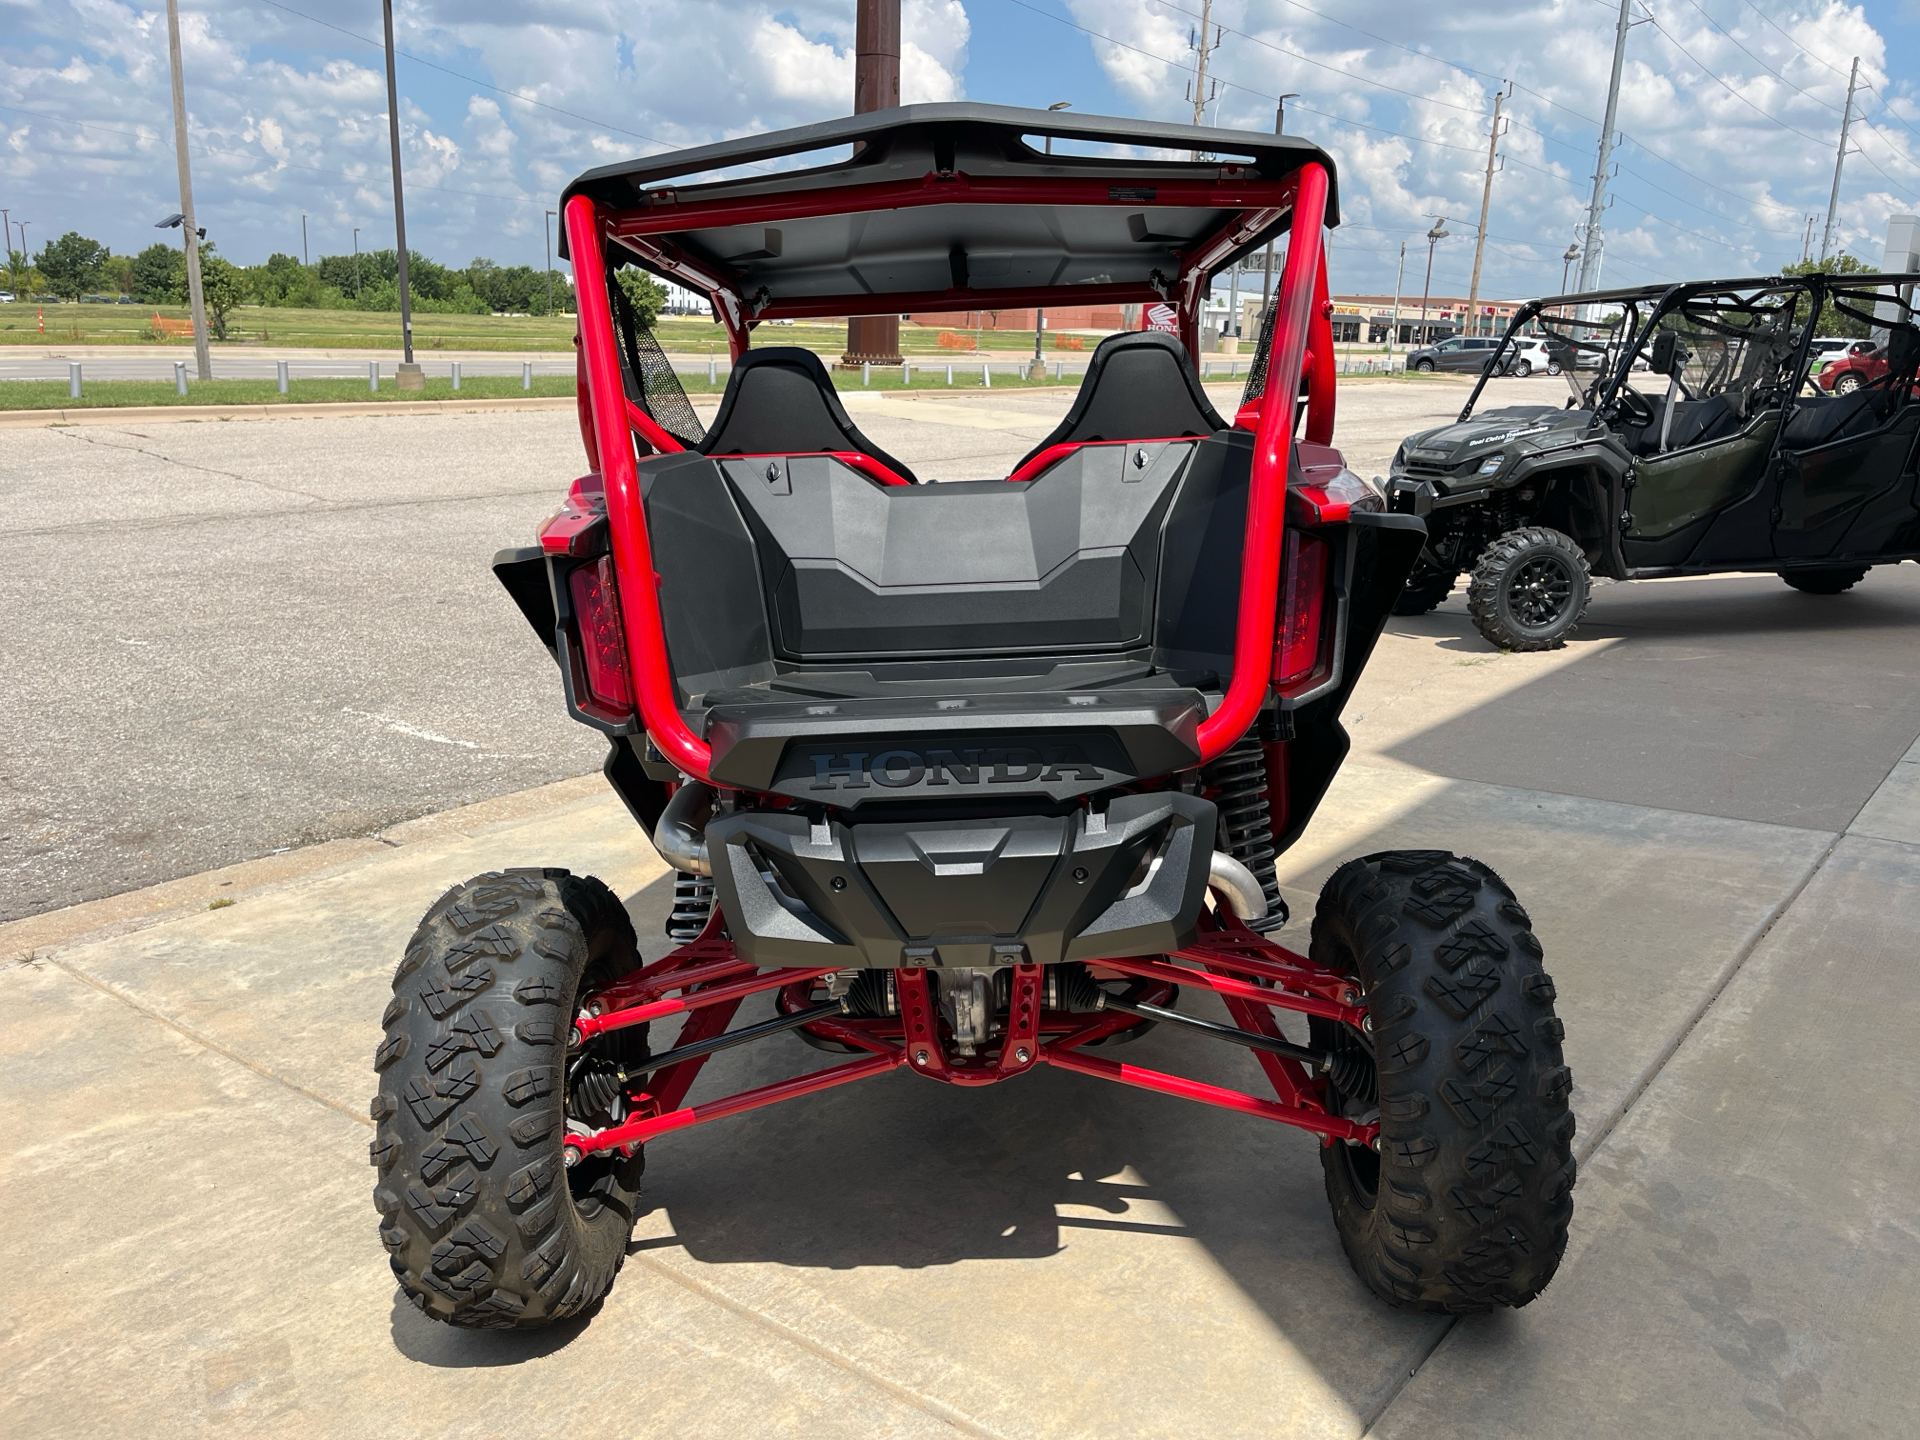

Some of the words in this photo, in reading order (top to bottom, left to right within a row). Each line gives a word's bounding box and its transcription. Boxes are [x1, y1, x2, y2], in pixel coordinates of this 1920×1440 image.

[1469, 437, 1485, 447] Dual
[1485, 433, 1506, 443] Clutch
[809, 745, 1104, 791] HONDA
